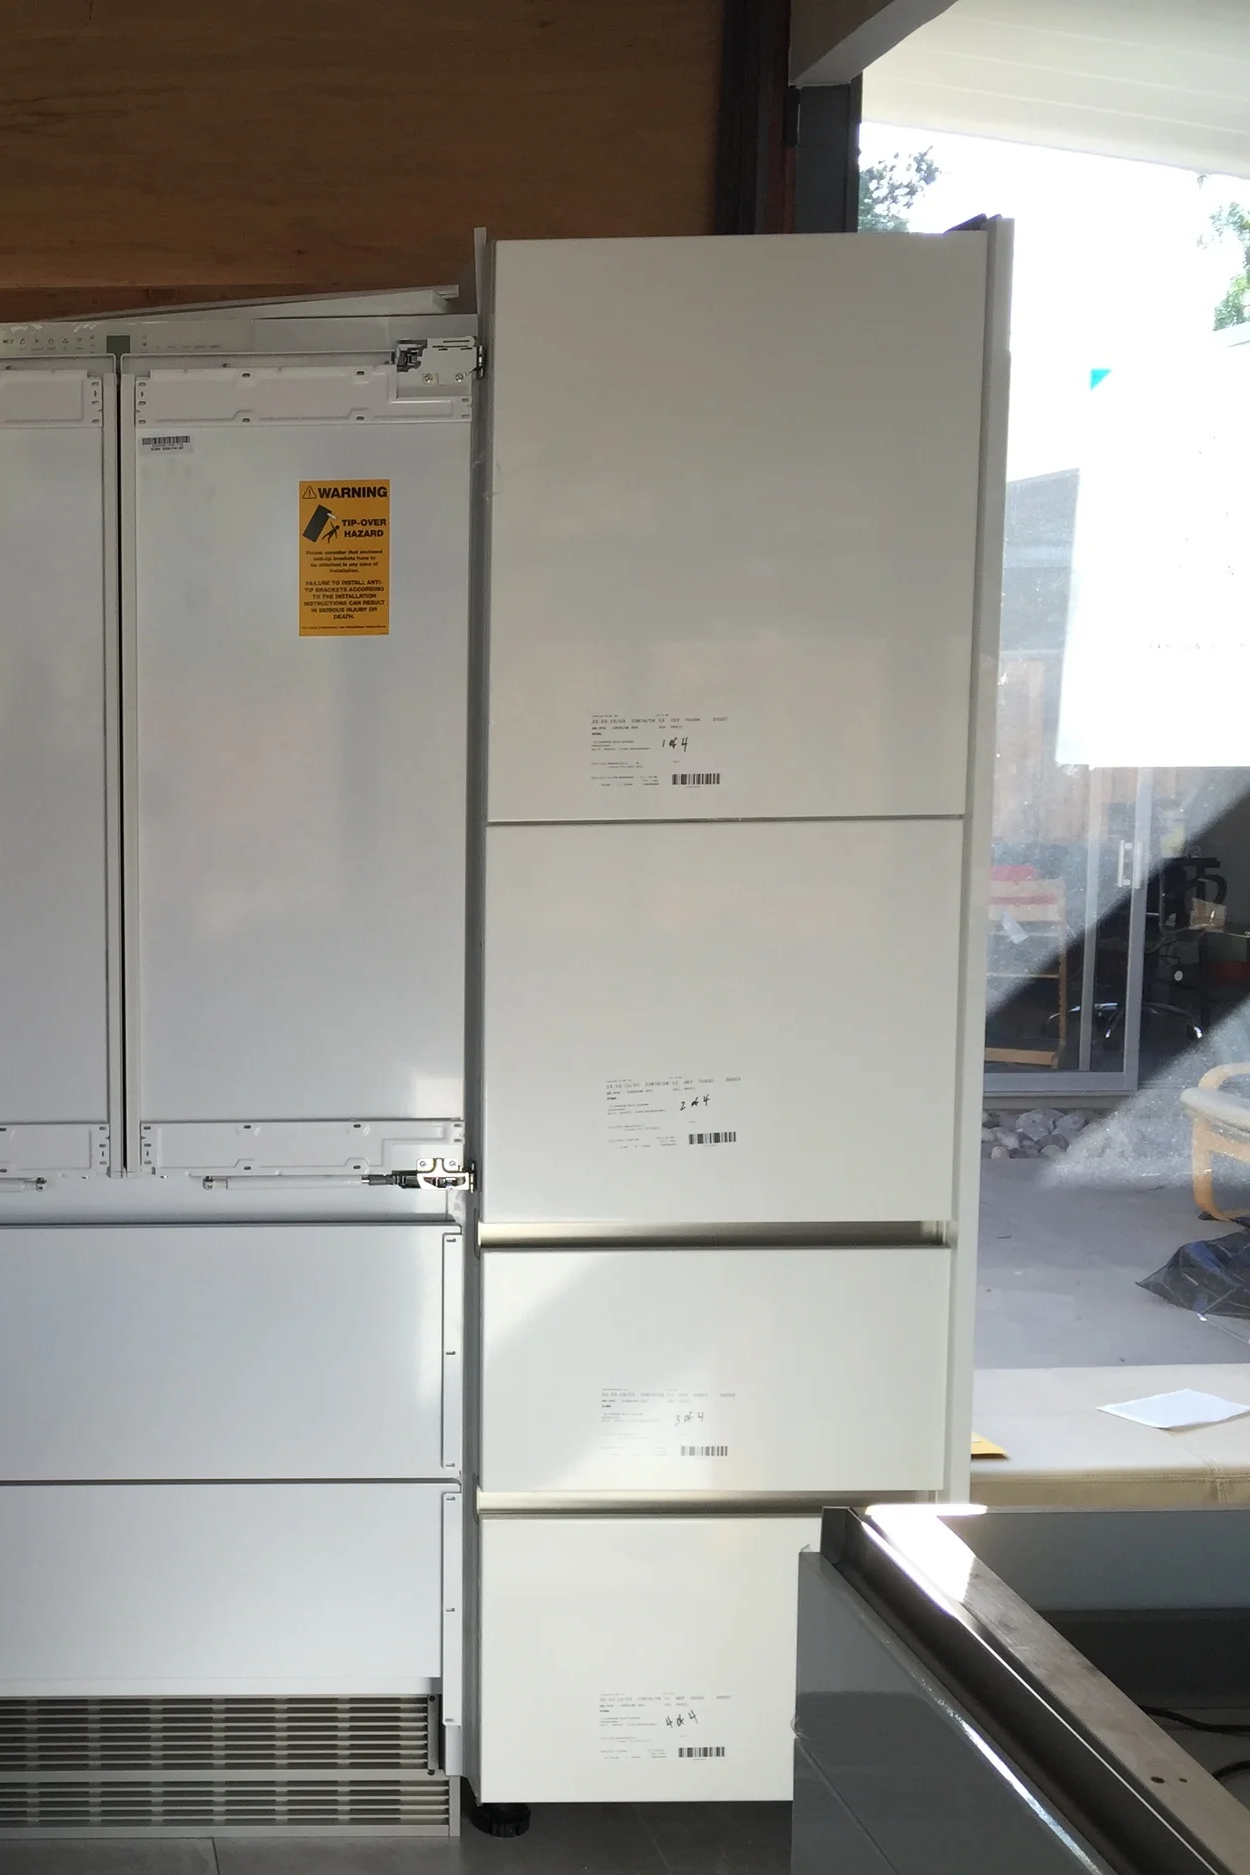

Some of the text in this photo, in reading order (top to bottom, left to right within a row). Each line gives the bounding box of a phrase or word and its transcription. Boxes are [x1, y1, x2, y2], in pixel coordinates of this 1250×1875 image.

[318, 486, 388, 498] WARNING
[681, 737, 688, 752] 4
[680, 1101, 686, 1111] 2
[703, 1093, 710, 1106] 4
[674, 1414, 680, 1427] 3
[697, 1411, 704, 1422] 4
[665, 1716, 673, 1728] 4
[688, 1710, 698, 1724] 4
